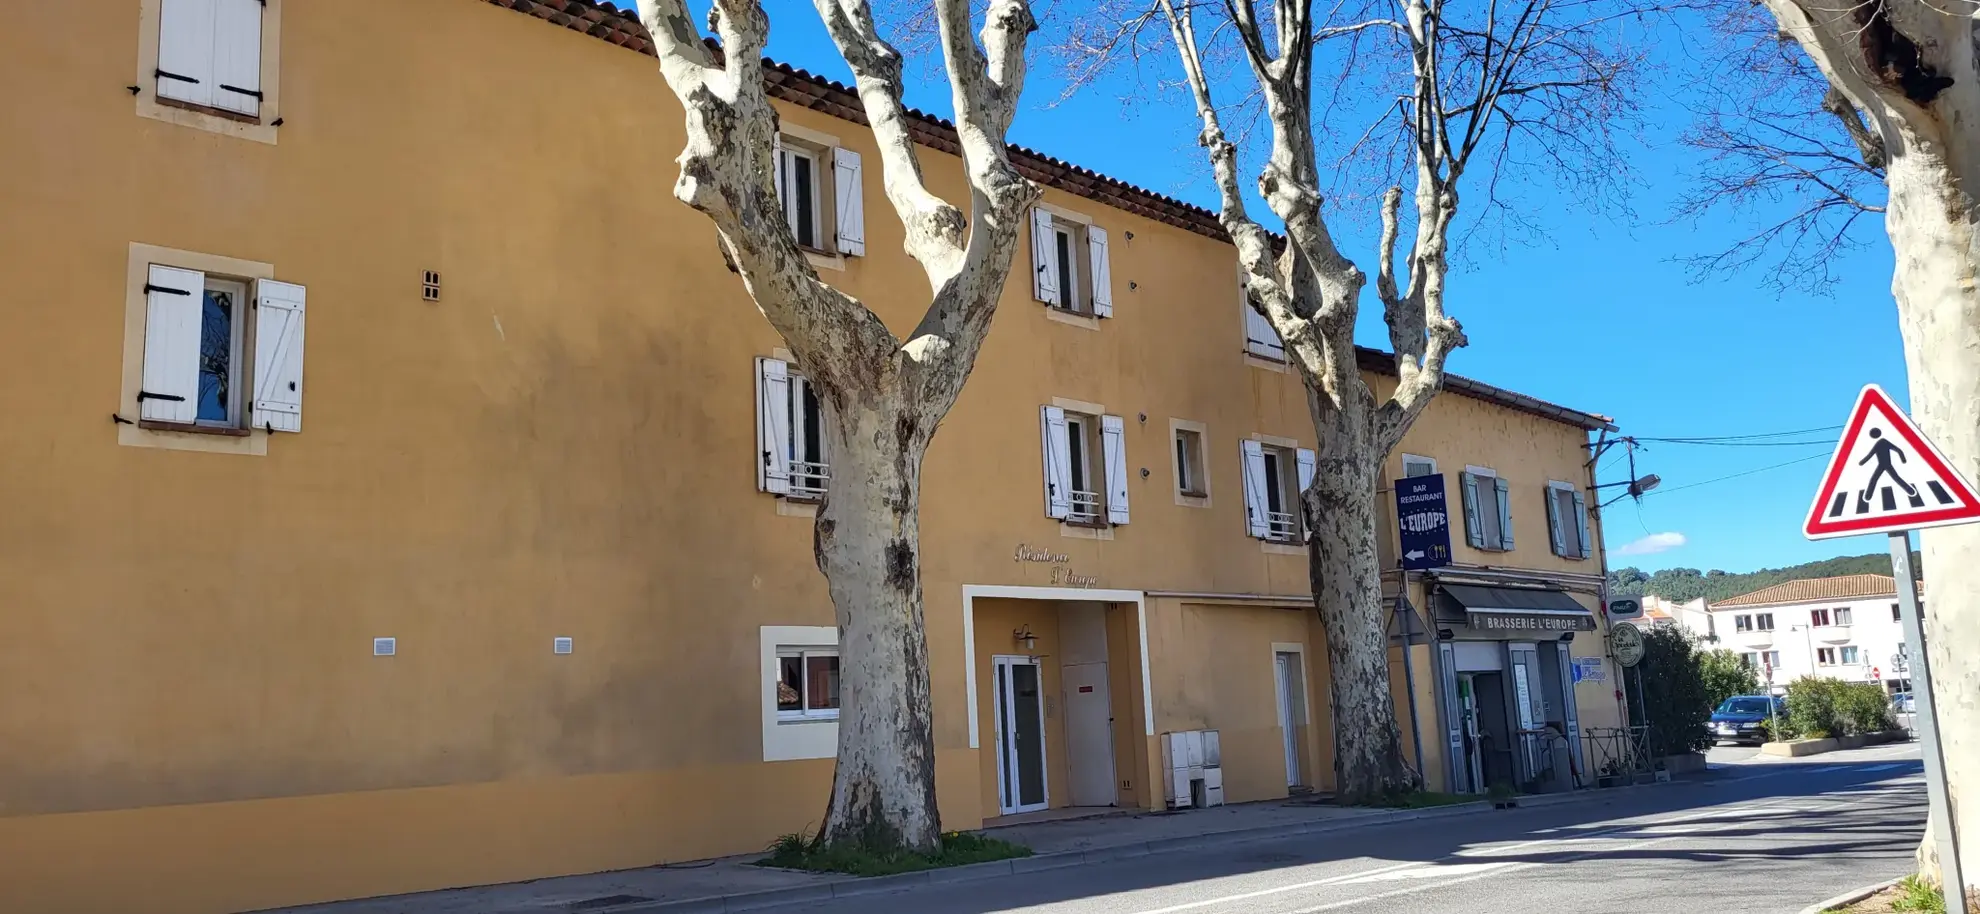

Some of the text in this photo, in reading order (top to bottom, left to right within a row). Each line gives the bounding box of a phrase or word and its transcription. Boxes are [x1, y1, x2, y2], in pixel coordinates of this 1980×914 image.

[1412, 484, 1427, 493] BAR
[1400, 492, 1443, 504] RESTAURANT
[1400, 511, 1446, 532] L'EUROPE
[1014, 543, 1070, 563] Résidence
[1487, 617, 1577, 630] BRASSERIE L'EUROPE
